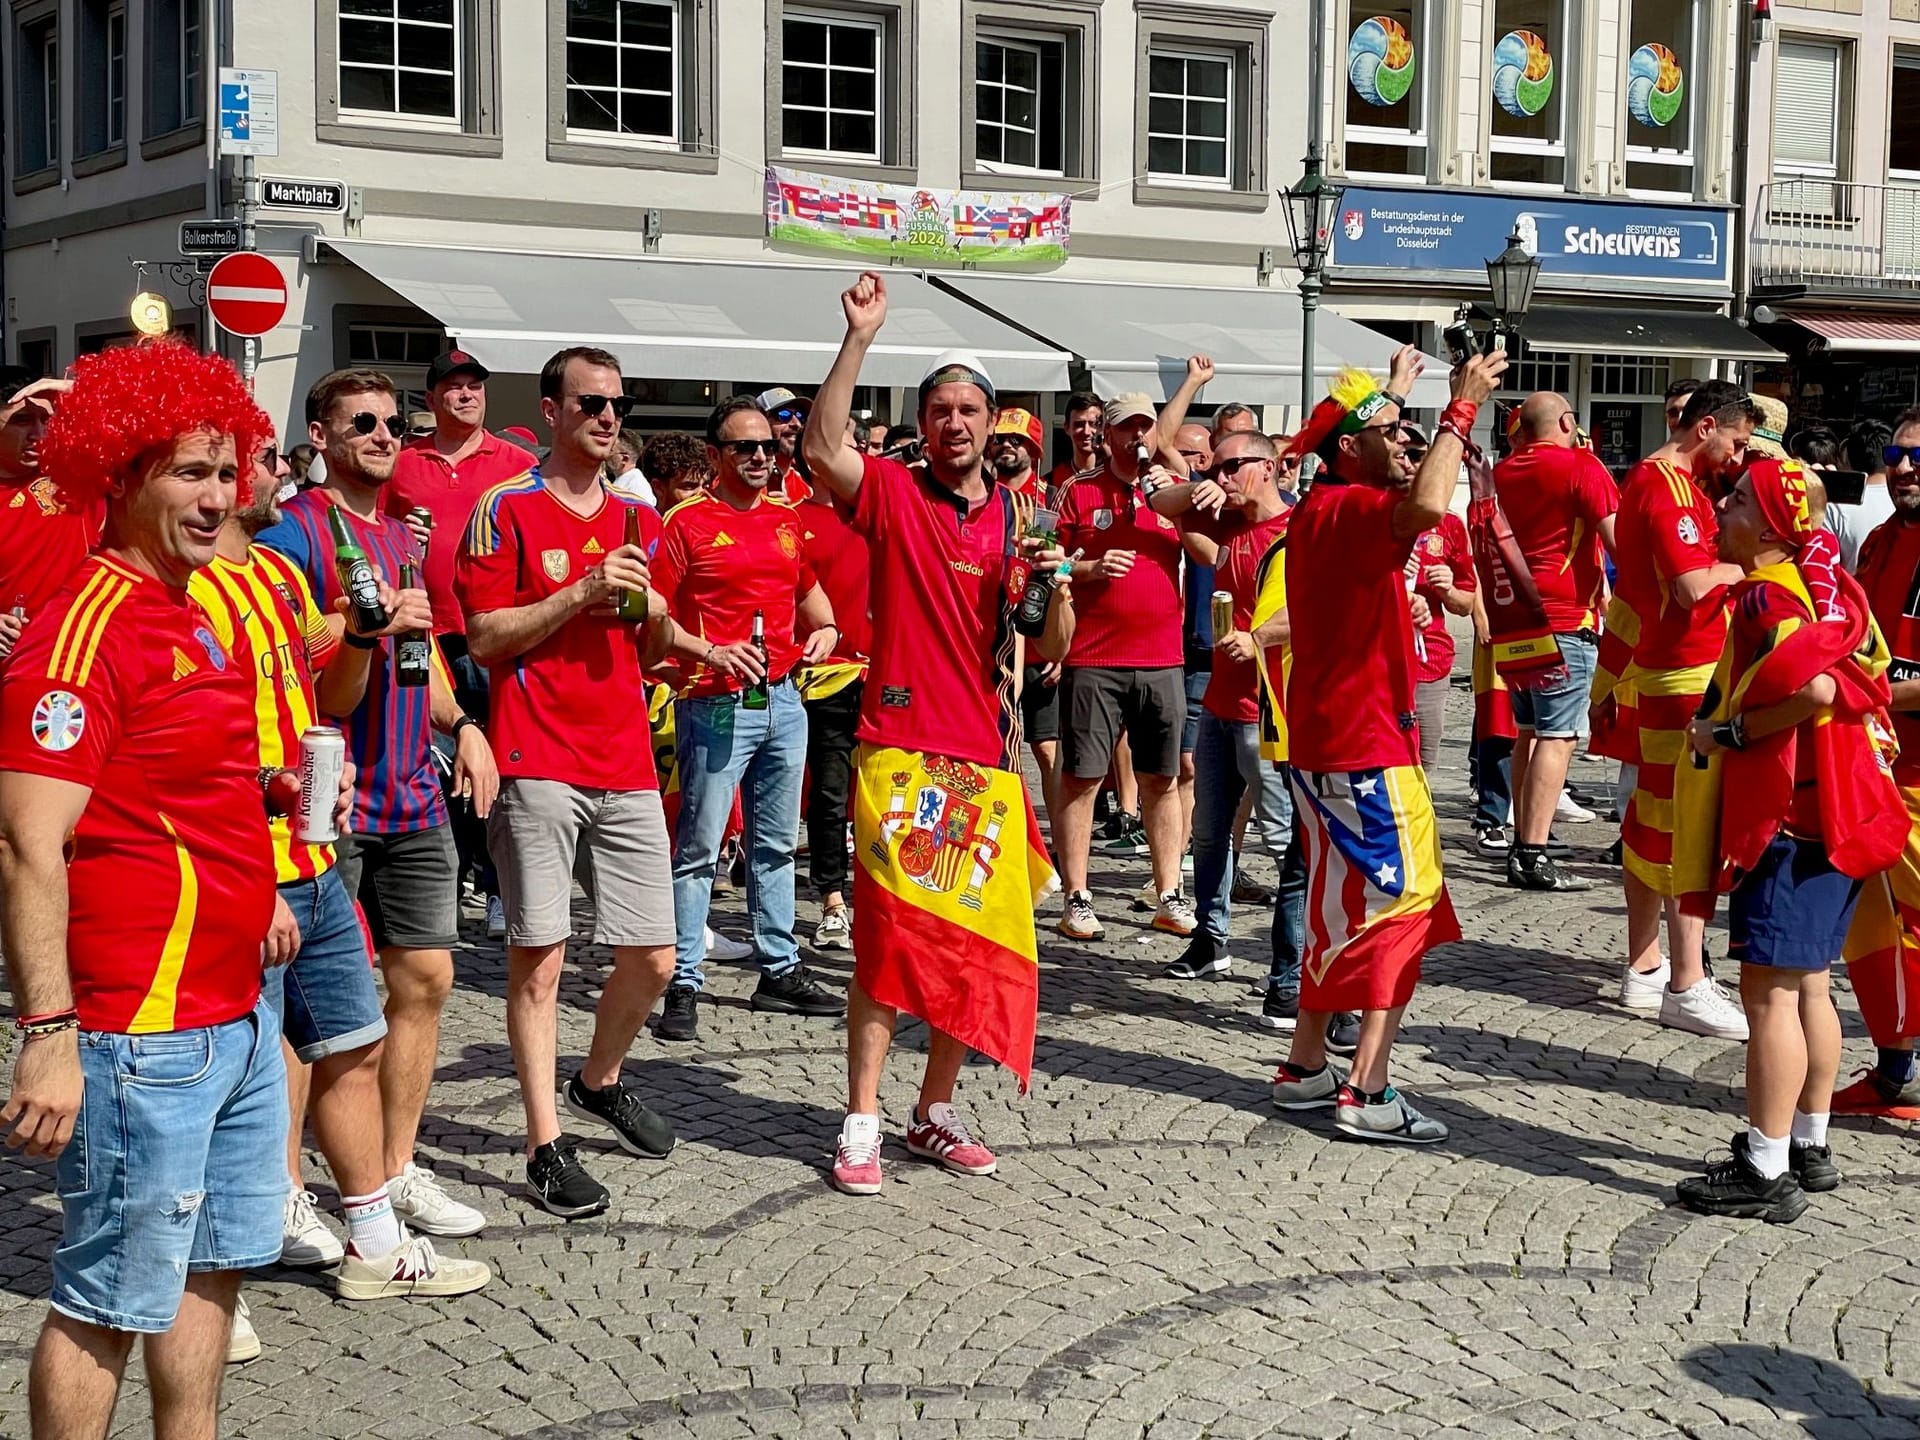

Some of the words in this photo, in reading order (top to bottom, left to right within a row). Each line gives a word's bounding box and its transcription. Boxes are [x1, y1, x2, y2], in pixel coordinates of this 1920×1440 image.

[271, 184, 334, 204] Marktplatz
[917, 211, 935, 222] EM
[1370, 208, 1441, 223] Bestattungsdienst
[1442, 212, 1450, 222] in
[1451, 212, 1465, 223] der
[905, 221, 949, 235] FUSSBALL
[1383, 223, 1452, 238] Landeshauptstadt
[1625, 224, 1680, 237] BESTATTUNGEN
[184, 230, 237, 246] Bolkerstraße
[910, 231, 945, 247] 2024
[1396, 237, 1439, 249] Düsseldorf
[1564, 226, 1681, 258] Scheuvens
[298, 748, 315, 817] Krombacher
